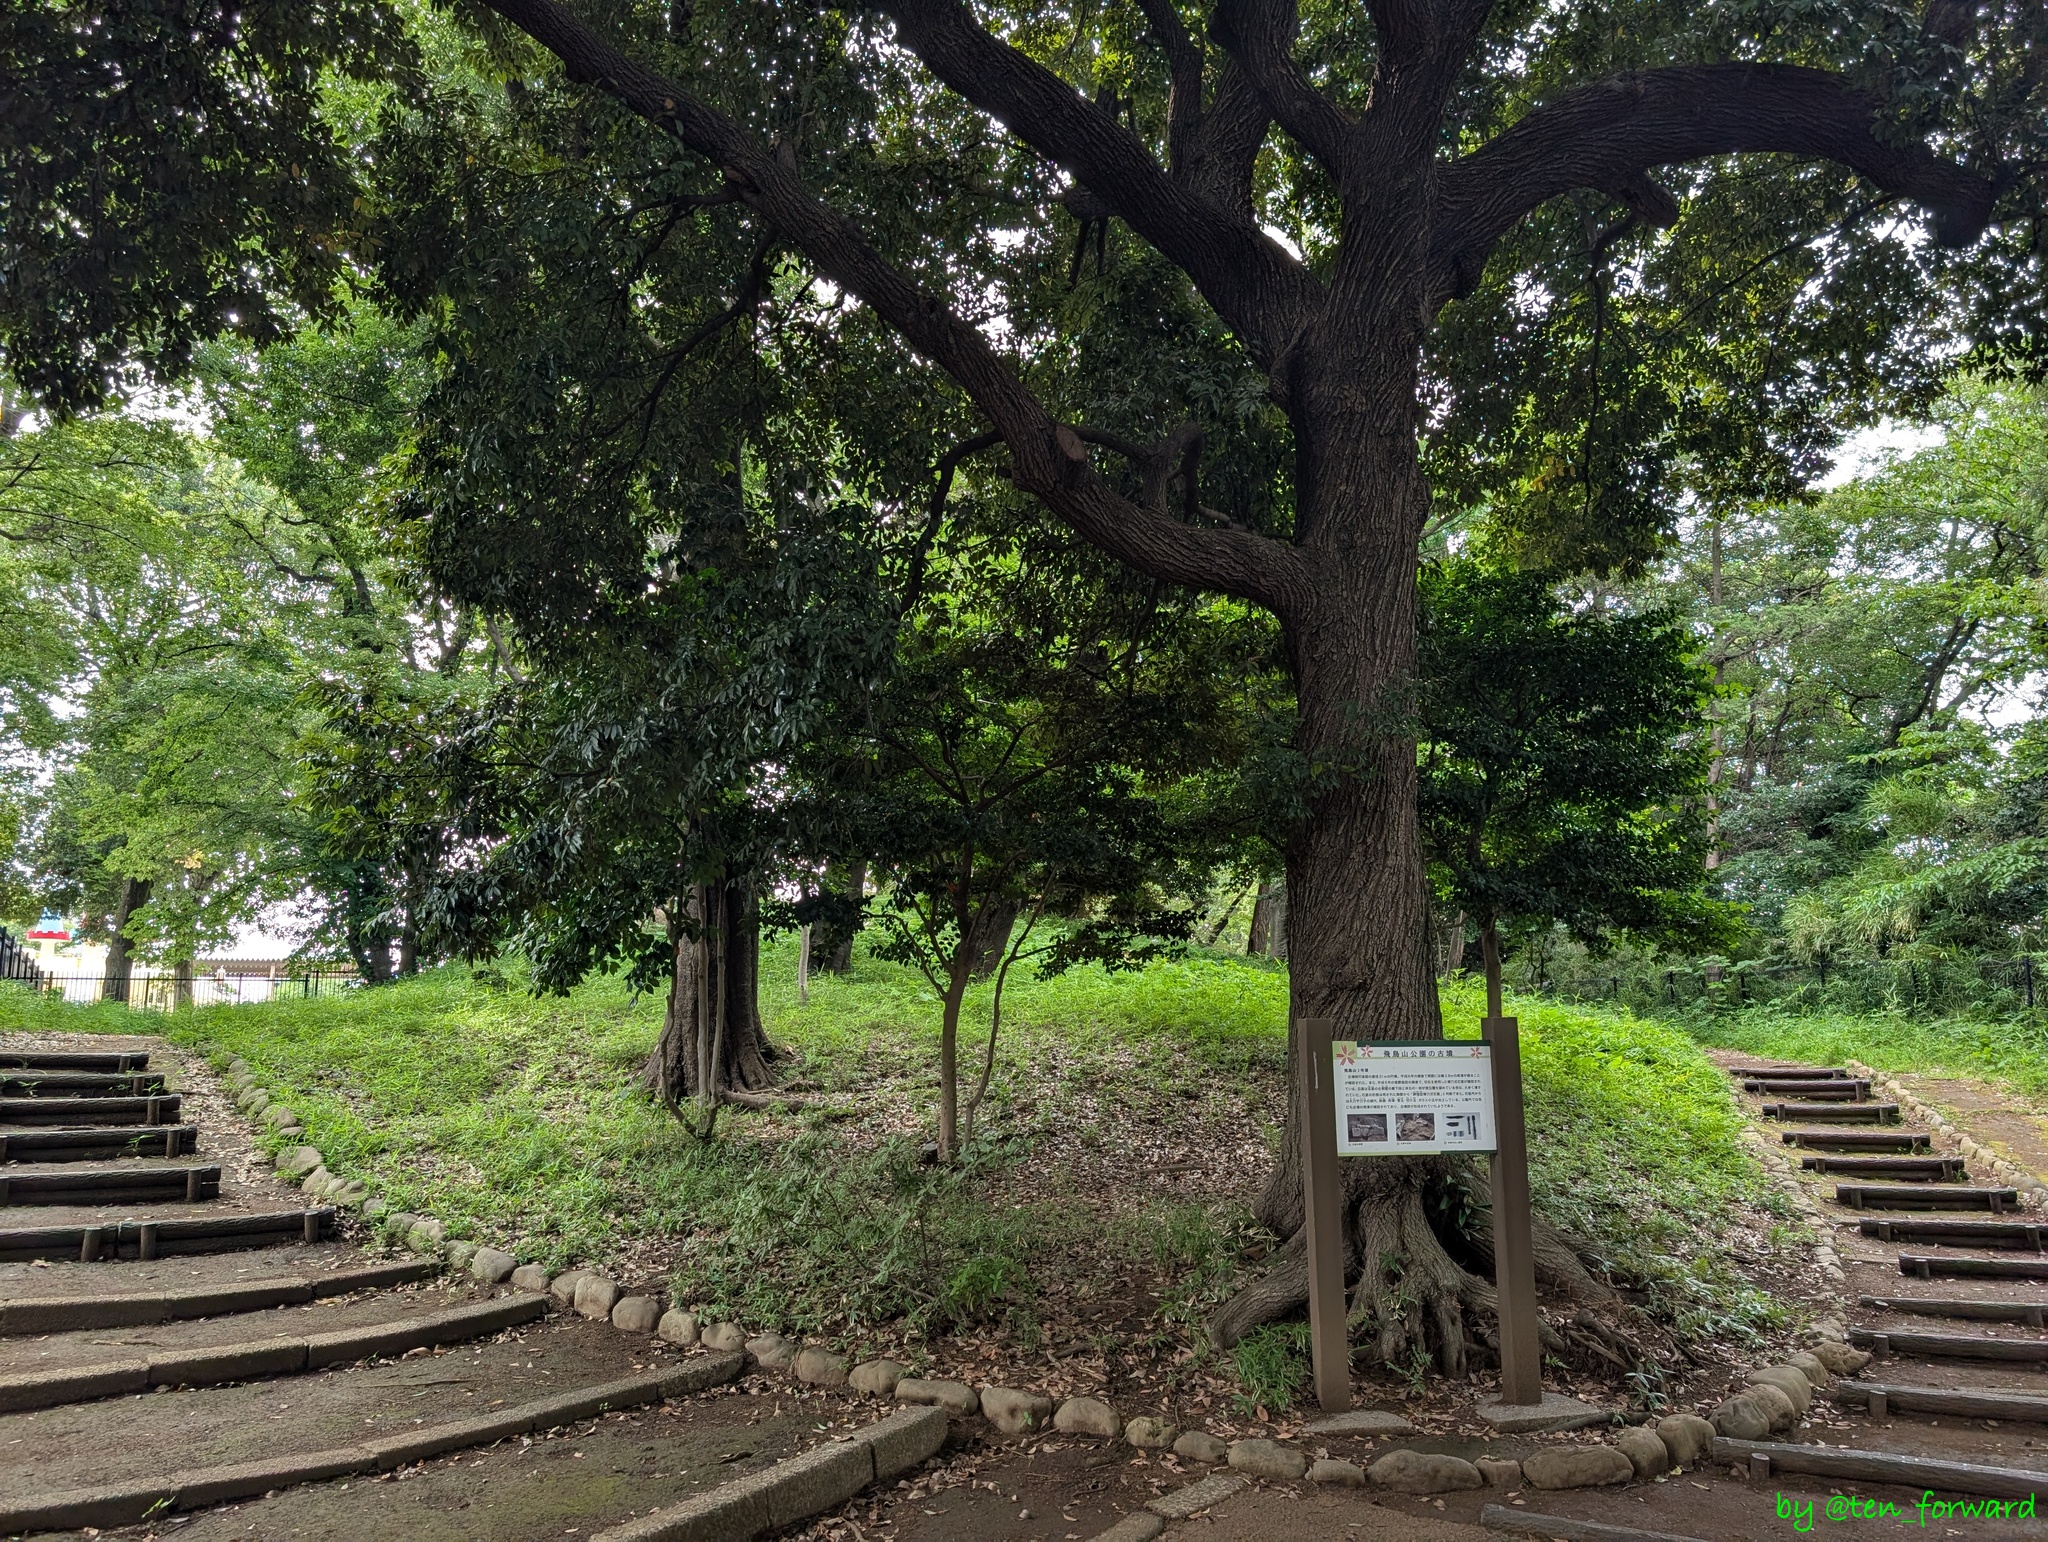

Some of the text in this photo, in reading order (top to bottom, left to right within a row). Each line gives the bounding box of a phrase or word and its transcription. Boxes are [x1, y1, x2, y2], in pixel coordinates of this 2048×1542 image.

[1383, 1050, 1453, 1058] 飛鳥山公園の古墳
